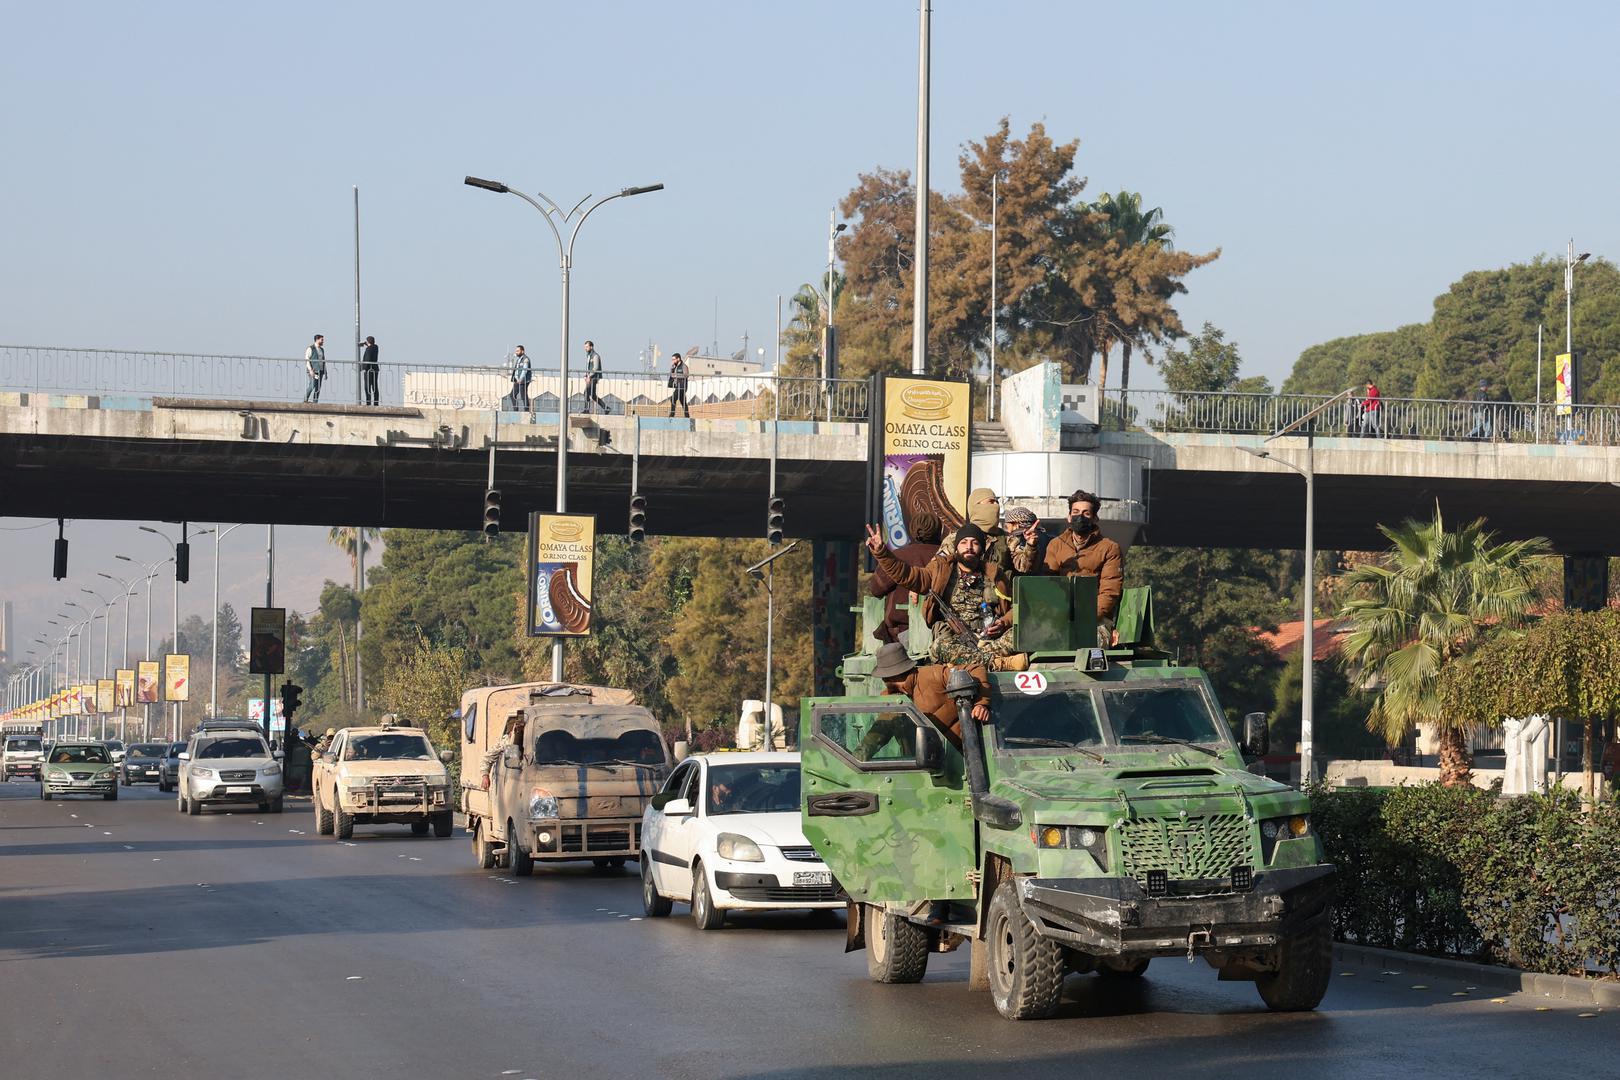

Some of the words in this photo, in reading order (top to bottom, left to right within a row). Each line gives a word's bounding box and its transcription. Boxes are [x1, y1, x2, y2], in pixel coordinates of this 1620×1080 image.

[885, 422, 928, 436] OMAYA
[929, 424, 966, 438] CLASS
[931, 440, 961, 451] CLASS
[540, 543, 568, 552] OMAYA
[568, 544, 593, 553] CLASS
[1018, 674, 1042, 689] 21
